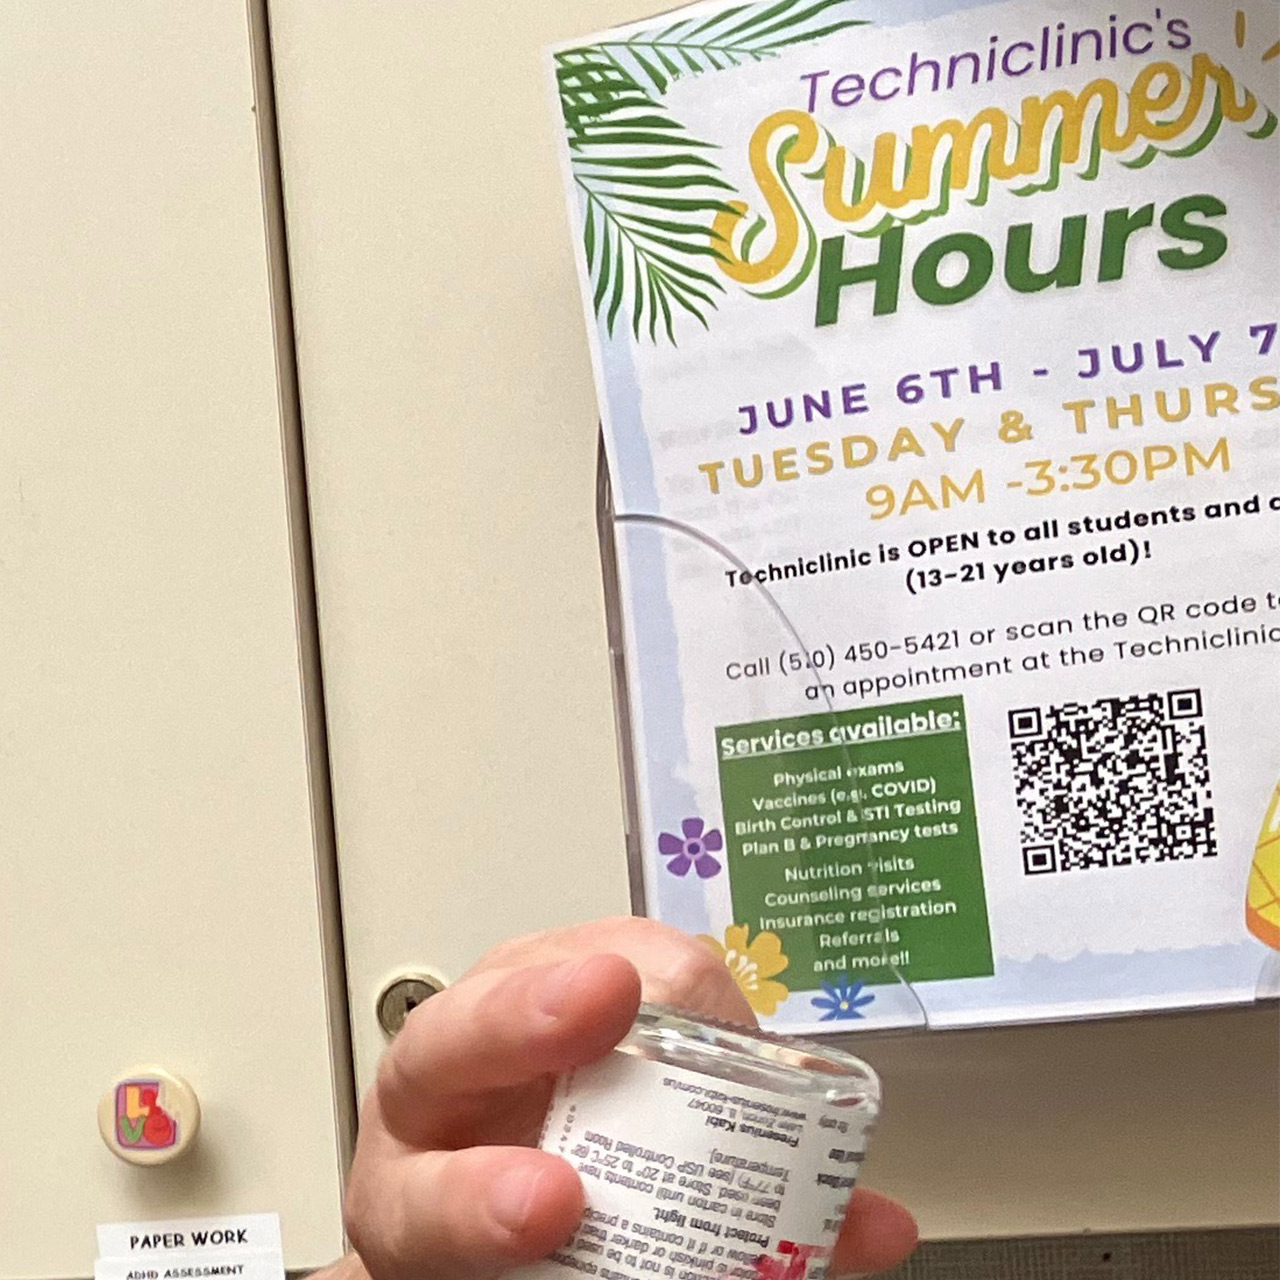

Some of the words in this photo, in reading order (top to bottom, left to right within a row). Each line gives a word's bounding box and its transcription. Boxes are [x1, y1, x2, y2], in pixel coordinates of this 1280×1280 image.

[799, 8, 1192, 114] Techniclinic's
[710, 53, 1262, 288] Summer
[815, 194, 1230, 327] Hours
[738, 383, 869, 436] JUNE
[896, 361, 1004, 405] 6TH
[1033, 368, 1050, 378] -
[1078, 331, 1222, 380] JULY
[697, 417, 966, 495] TUESDAY
[998, 409, 1035, 445] &
[865, 468, 987, 521] 9AM
[725, 549, 873, 588] Techniclinic
[878, 543, 900, 564] is
[907, 531, 980, 558] OPEN
[987, 528, 1016, 547] to
[1023, 519, 1059, 543] all
[1067, 504, 1196, 536] students
[1204, 494, 1261, 519] and
[993, 553, 1075, 584] years
[1082, 538, 1152, 566] old)!
[726, 656, 771, 680] Call
[844, 629, 959, 663] 450-5421
[969, 629, 996, 646] or
[1005, 617, 1073, 642] scan
[1083, 611, 1128, 631] the
[1138, 603, 1175, 626] QR
[1185, 595, 1257, 619] code
[842, 656, 1013, 698] appointment
[1021, 651, 1051, 672] at
[1059, 647, 1104, 667] the
[720, 726, 825, 757] Services
[829, 710, 962, 744] available:
[773, 765, 842, 788] Physical
[752, 790, 827, 812] Vaccines
[871, 776, 937, 799] COVID)
[735, 818, 777, 836] Birth
[780, 809, 842, 831] Control
[846, 808, 859, 823] &
[863, 805, 890, 822] STI
[894, 798, 962, 818] Testing
[742, 839, 780, 856] Plan
[784, 838, 796, 852] B
[800, 837, 812, 851] &
[815, 826, 910, 850] Pregnancy
[913, 821, 959, 839] tests
[784, 861, 863, 883] Nutrition
[765, 885, 863, 907] Counseling
[866, 876, 942, 897] services
[760, 909, 845, 930] Insurance
[850, 899, 958, 924] registration
[819, 928, 901, 949] Referrals
[813, 954, 847, 972] and
[687, 1098, 724, 1115] 60047
[706, 1115, 736, 1132] Kabi
[584, 1130, 613, 1151] Room
[739, 1123, 799, 1148] Fresenius
[591, 1150, 620, 1169] 25°C
[614, 1140, 675, 1169] Controlled
[621, 1159, 634, 1173] to
[635, 1165, 660, 1181] 20°
[676, 1160, 705, 1177] USP
[604, 1170, 654, 1194] contents
[661, 1171, 676, 1184] at
[678, 1176, 713, 1196] Store
[655, 1187, 685, 1203] until
[687, 1196, 728, 1214] carton
[653, 1207, 687, 1228] light.
[730, 1207, 743, 1220] in
[745, 1210, 777, 1228] Store
[620, 1219, 629, 1230] a
[631, 1223, 684, 1246] contains
[689, 1217, 722, 1237] from
[130, 1232, 185, 1251] PAPER
[191, 1228, 249, 1247] WORK
[609, 1233, 649, 1254] darker
[724, 1226, 770, 1248] Protect
[606, 1248, 622, 1263] be
[624, 1254, 637, 1268] to
[651, 1246, 666, 1258] or
[710, 1245, 725, 1256] or
[164, 1264, 245, 1279] ASSESSMENT
[639, 1259, 661, 1273] not
[663, 1265, 675, 1279] is
[668, 1251, 715, 1272] pinkish
